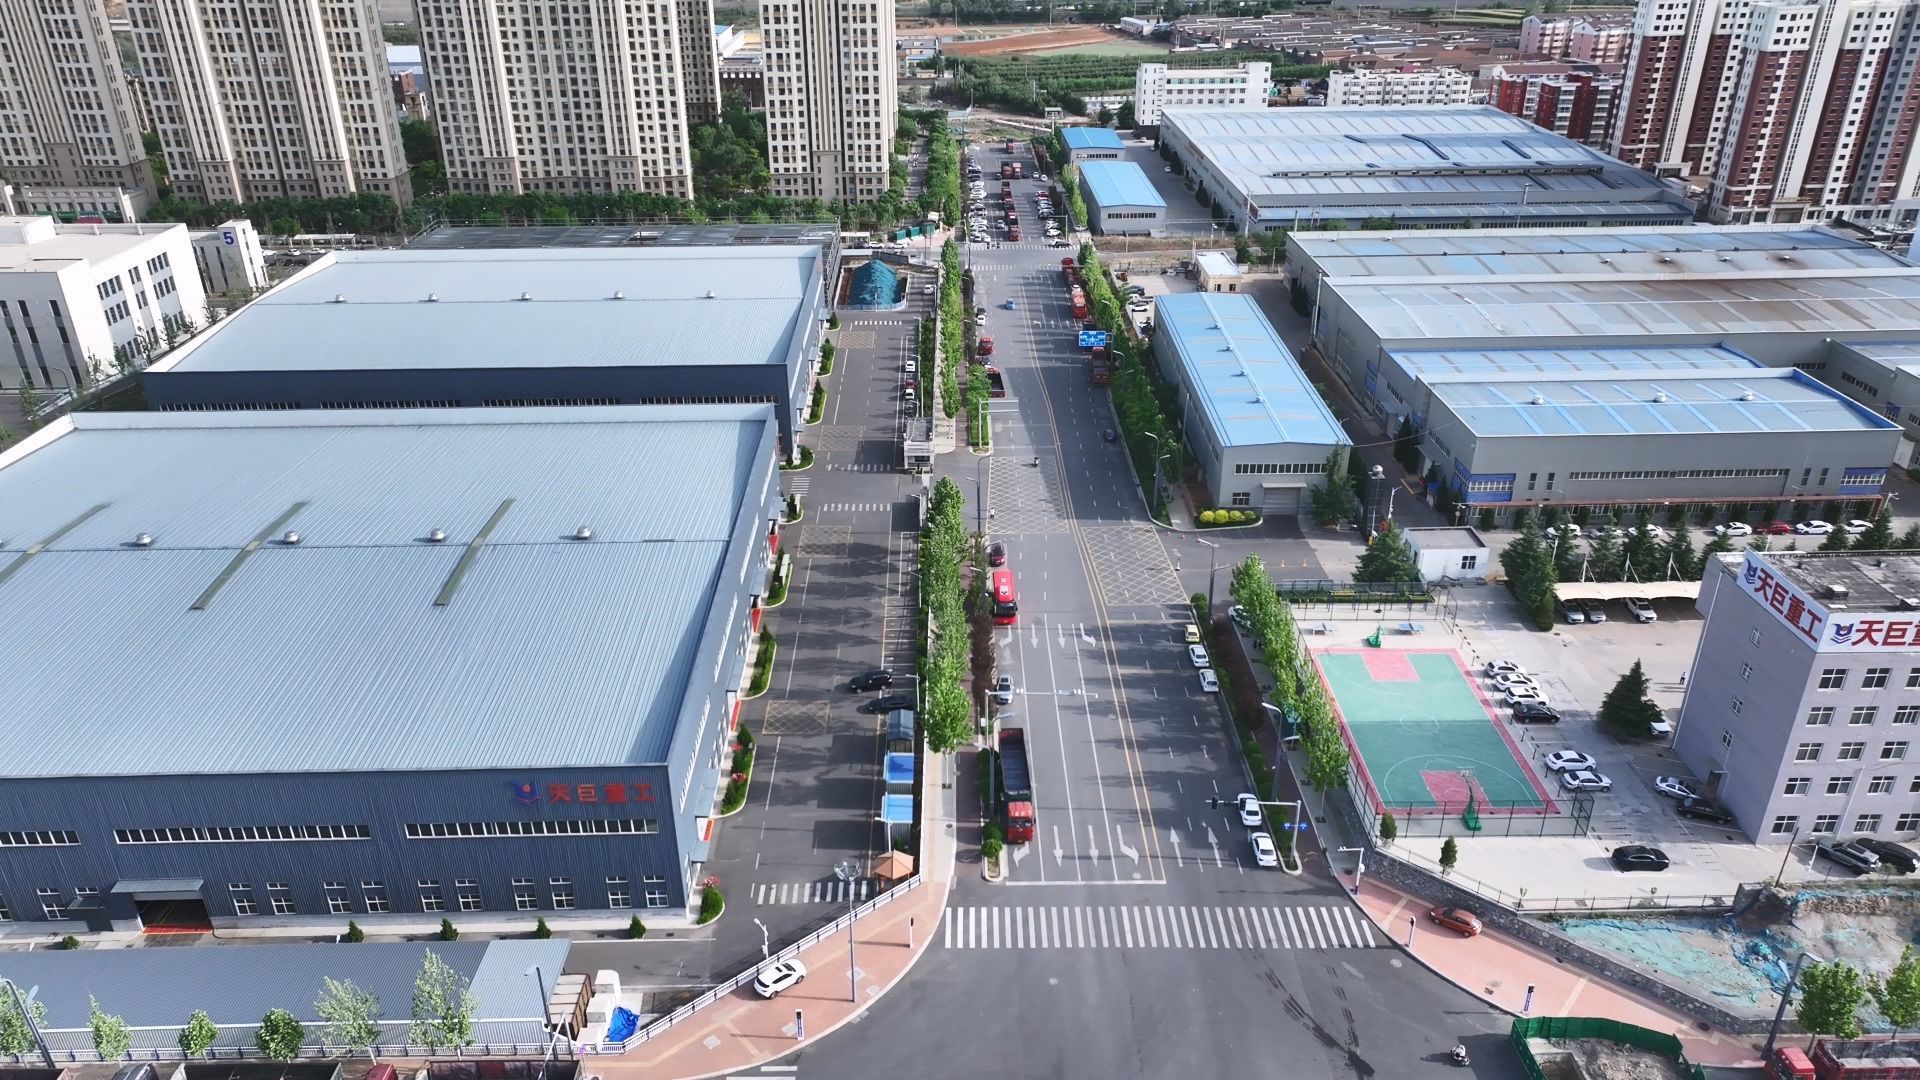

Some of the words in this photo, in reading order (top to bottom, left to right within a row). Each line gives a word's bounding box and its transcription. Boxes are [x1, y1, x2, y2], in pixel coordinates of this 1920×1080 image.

[223, 232, 234, 245] 5
[1754, 567, 1823, 643] 天巨重工
[547, 783, 656, 804] 天巨重工
